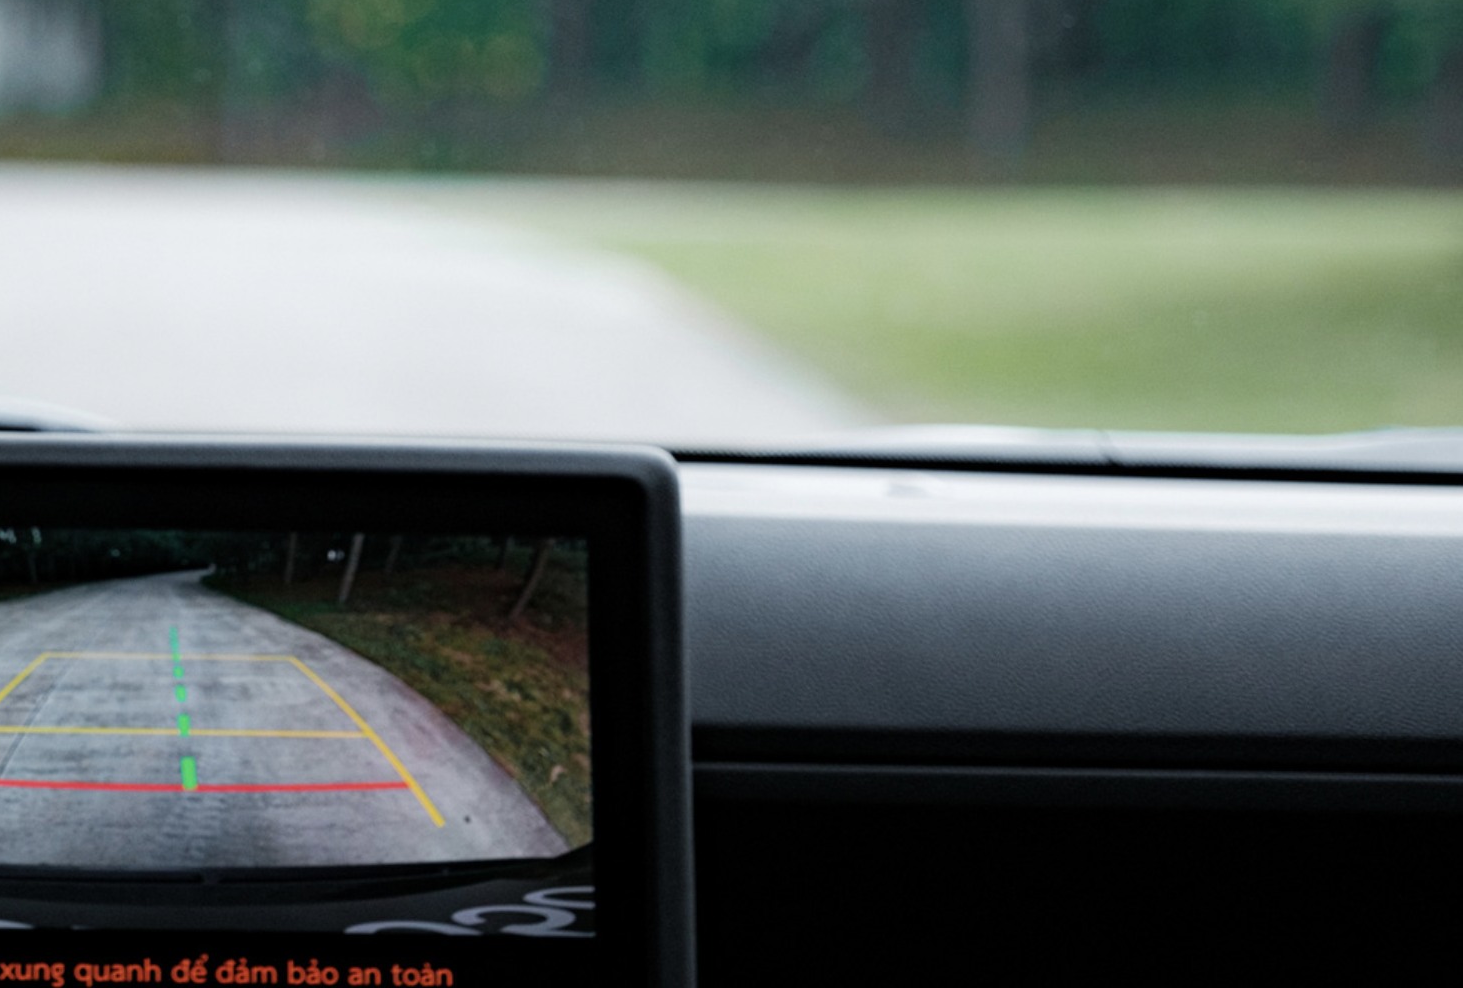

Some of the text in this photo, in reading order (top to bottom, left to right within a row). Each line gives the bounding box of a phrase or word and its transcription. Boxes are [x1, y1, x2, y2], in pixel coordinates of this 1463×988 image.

[73, 957, 162, 988] quanh
[170, 953, 209, 984] để
[214, 957, 278, 985] đảm
[287, 958, 340, 986] bảo
[347, 966, 382, 986] an
